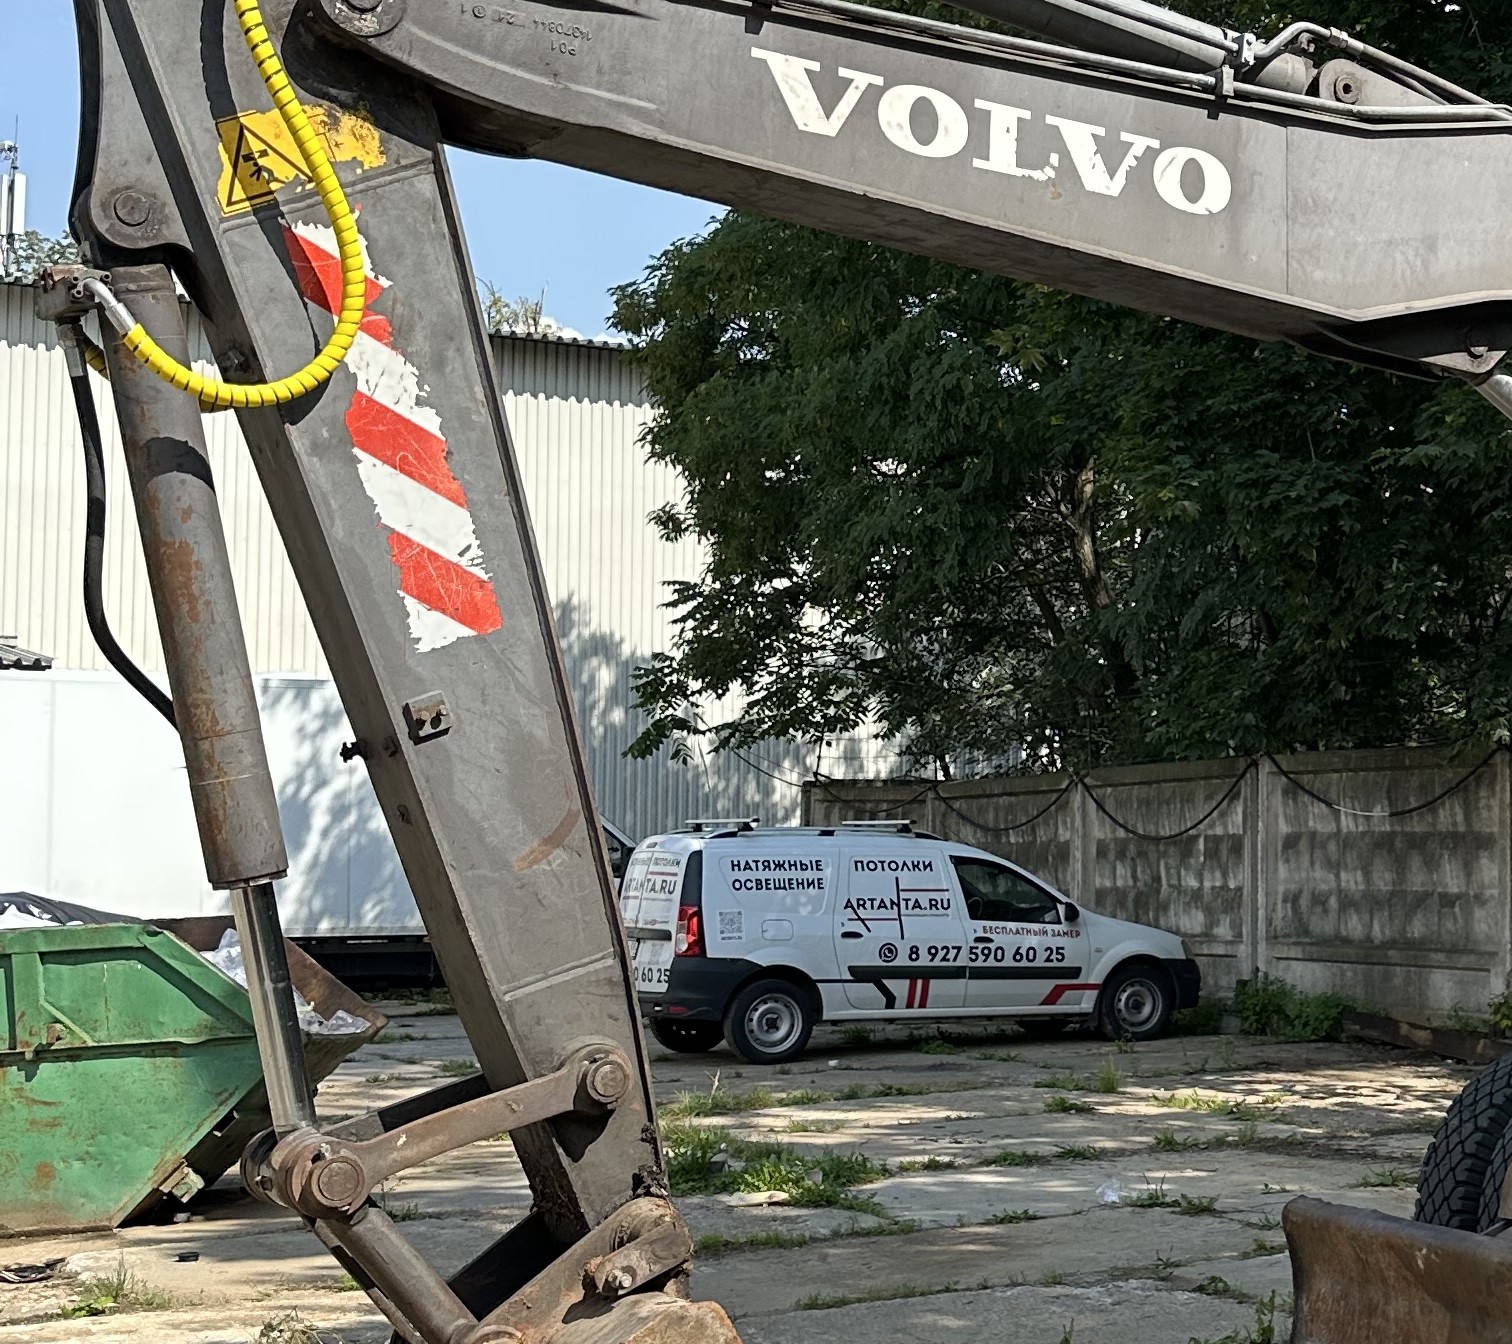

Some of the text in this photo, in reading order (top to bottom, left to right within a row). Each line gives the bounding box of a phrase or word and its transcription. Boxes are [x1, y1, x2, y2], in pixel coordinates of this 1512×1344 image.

[750, 47, 1232, 215] VOLVO
[731, 859, 934, 873] НАТЯЖНЫЕ ПОТОЛКИ
[731, 877, 825, 891] ОСВЕЩЕНИЕ
[843, 897, 951, 911] ARTANTA.RU
[982, 925, 1081, 939] БЕСПЛАТНЫЙ ЗАМЕР
[907, 945, 1066, 963] 8 927 590 60 25
[641, 966, 653, 983] 60
[656, 967, 671, 984] 25
